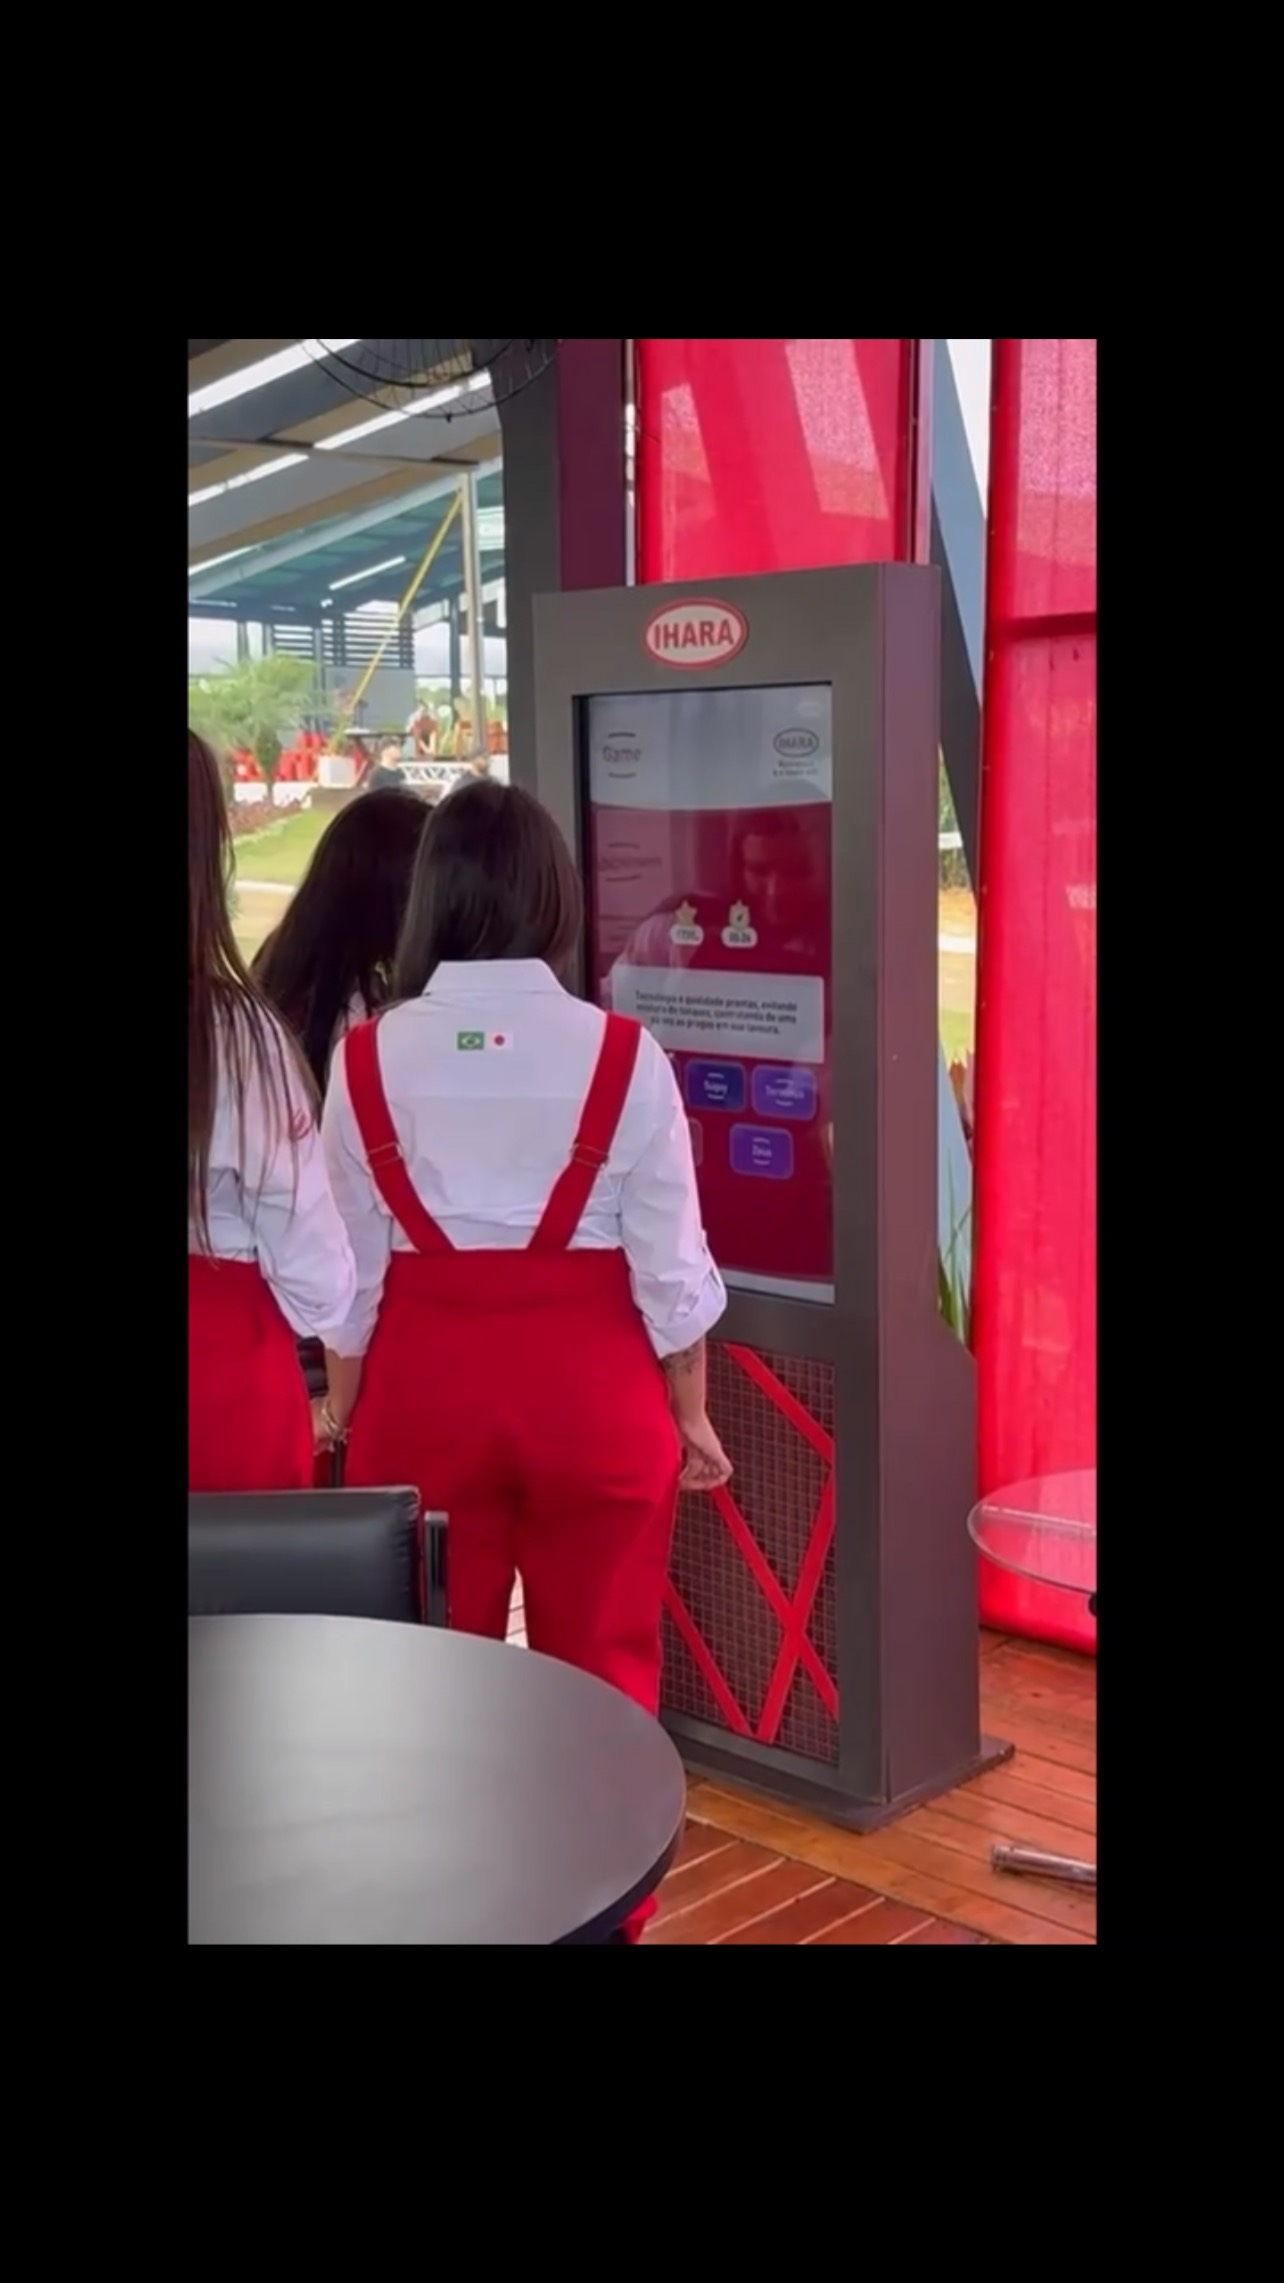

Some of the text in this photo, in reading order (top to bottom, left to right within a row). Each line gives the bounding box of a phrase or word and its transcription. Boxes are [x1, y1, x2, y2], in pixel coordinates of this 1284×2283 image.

[653, 619, 735, 650] IHARA
[778, 735, 815, 749] IHARA
[603, 745, 641, 763] Game
[685, 994, 724, 1007] qualidade
[725, 999, 759, 1010] prontas,
[760, 1001, 798, 1012] evitando
[765, 1011, 776, 1022] de
[777, 1015, 797, 1024] uma
